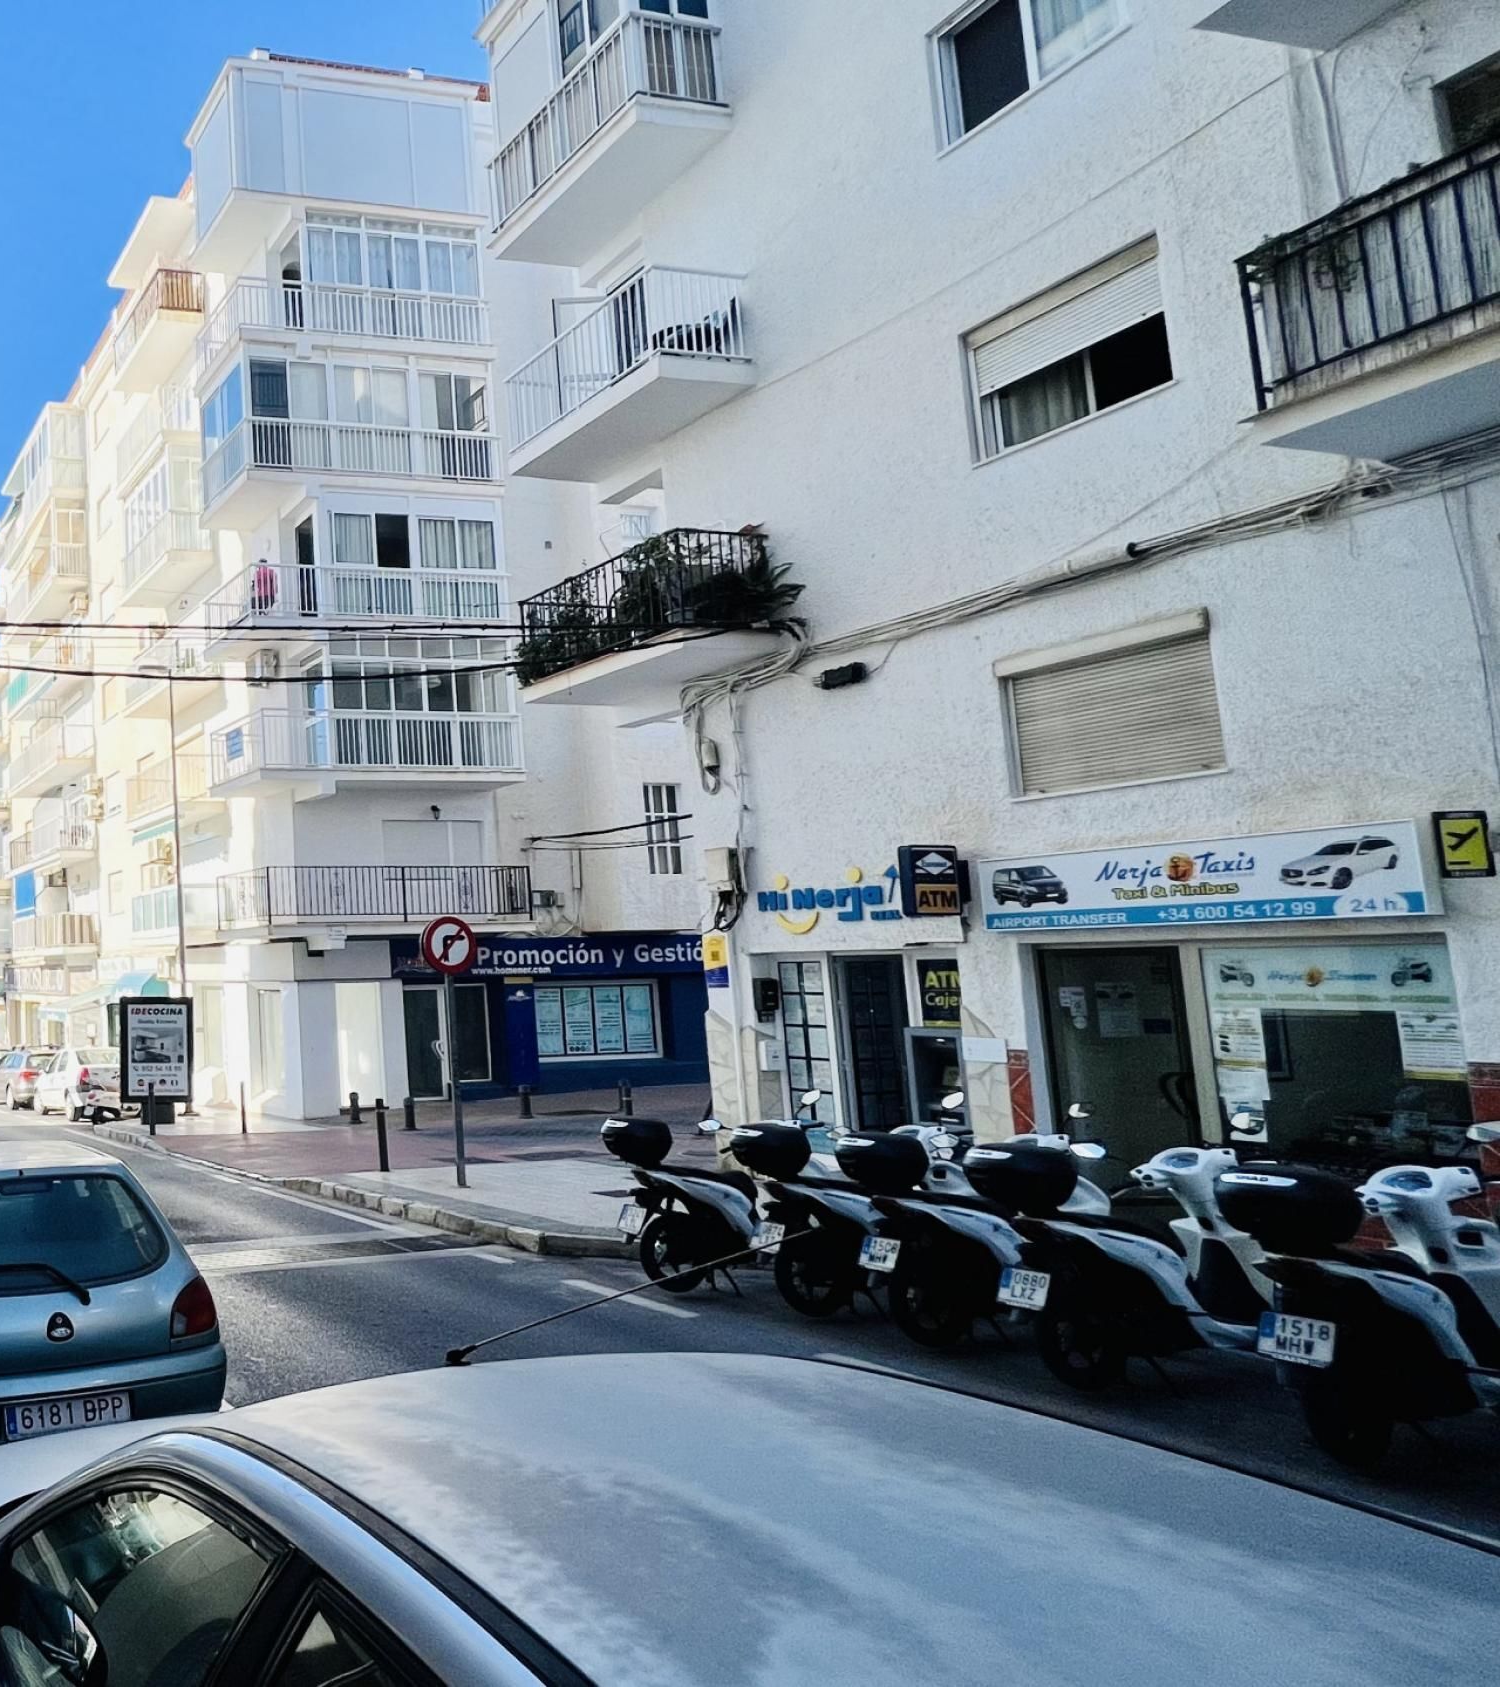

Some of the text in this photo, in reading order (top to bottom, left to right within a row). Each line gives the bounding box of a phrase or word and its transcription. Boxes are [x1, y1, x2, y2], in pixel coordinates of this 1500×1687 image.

[1095, 851, 1255, 888] Nerja Taxis
[791, 865, 884, 922] Nerja
[919, 889, 958, 908] ATM
[1112, 882, 1240, 901] Taxi & Minibus
[1157, 901, 1317, 921] +34 600 54 12 99
[1349, 897, 1378, 912] 24
[992, 912, 1127, 929] AIRPORT TRANSFER
[476, 943, 605, 966] Promoción
[611, 948, 625, 968] y
[130, 1007, 184, 1016] IDECOCINA
[1280, 1317, 1330, 1341] 1518
[21, 1396, 123, 1430] 6181 BPP
